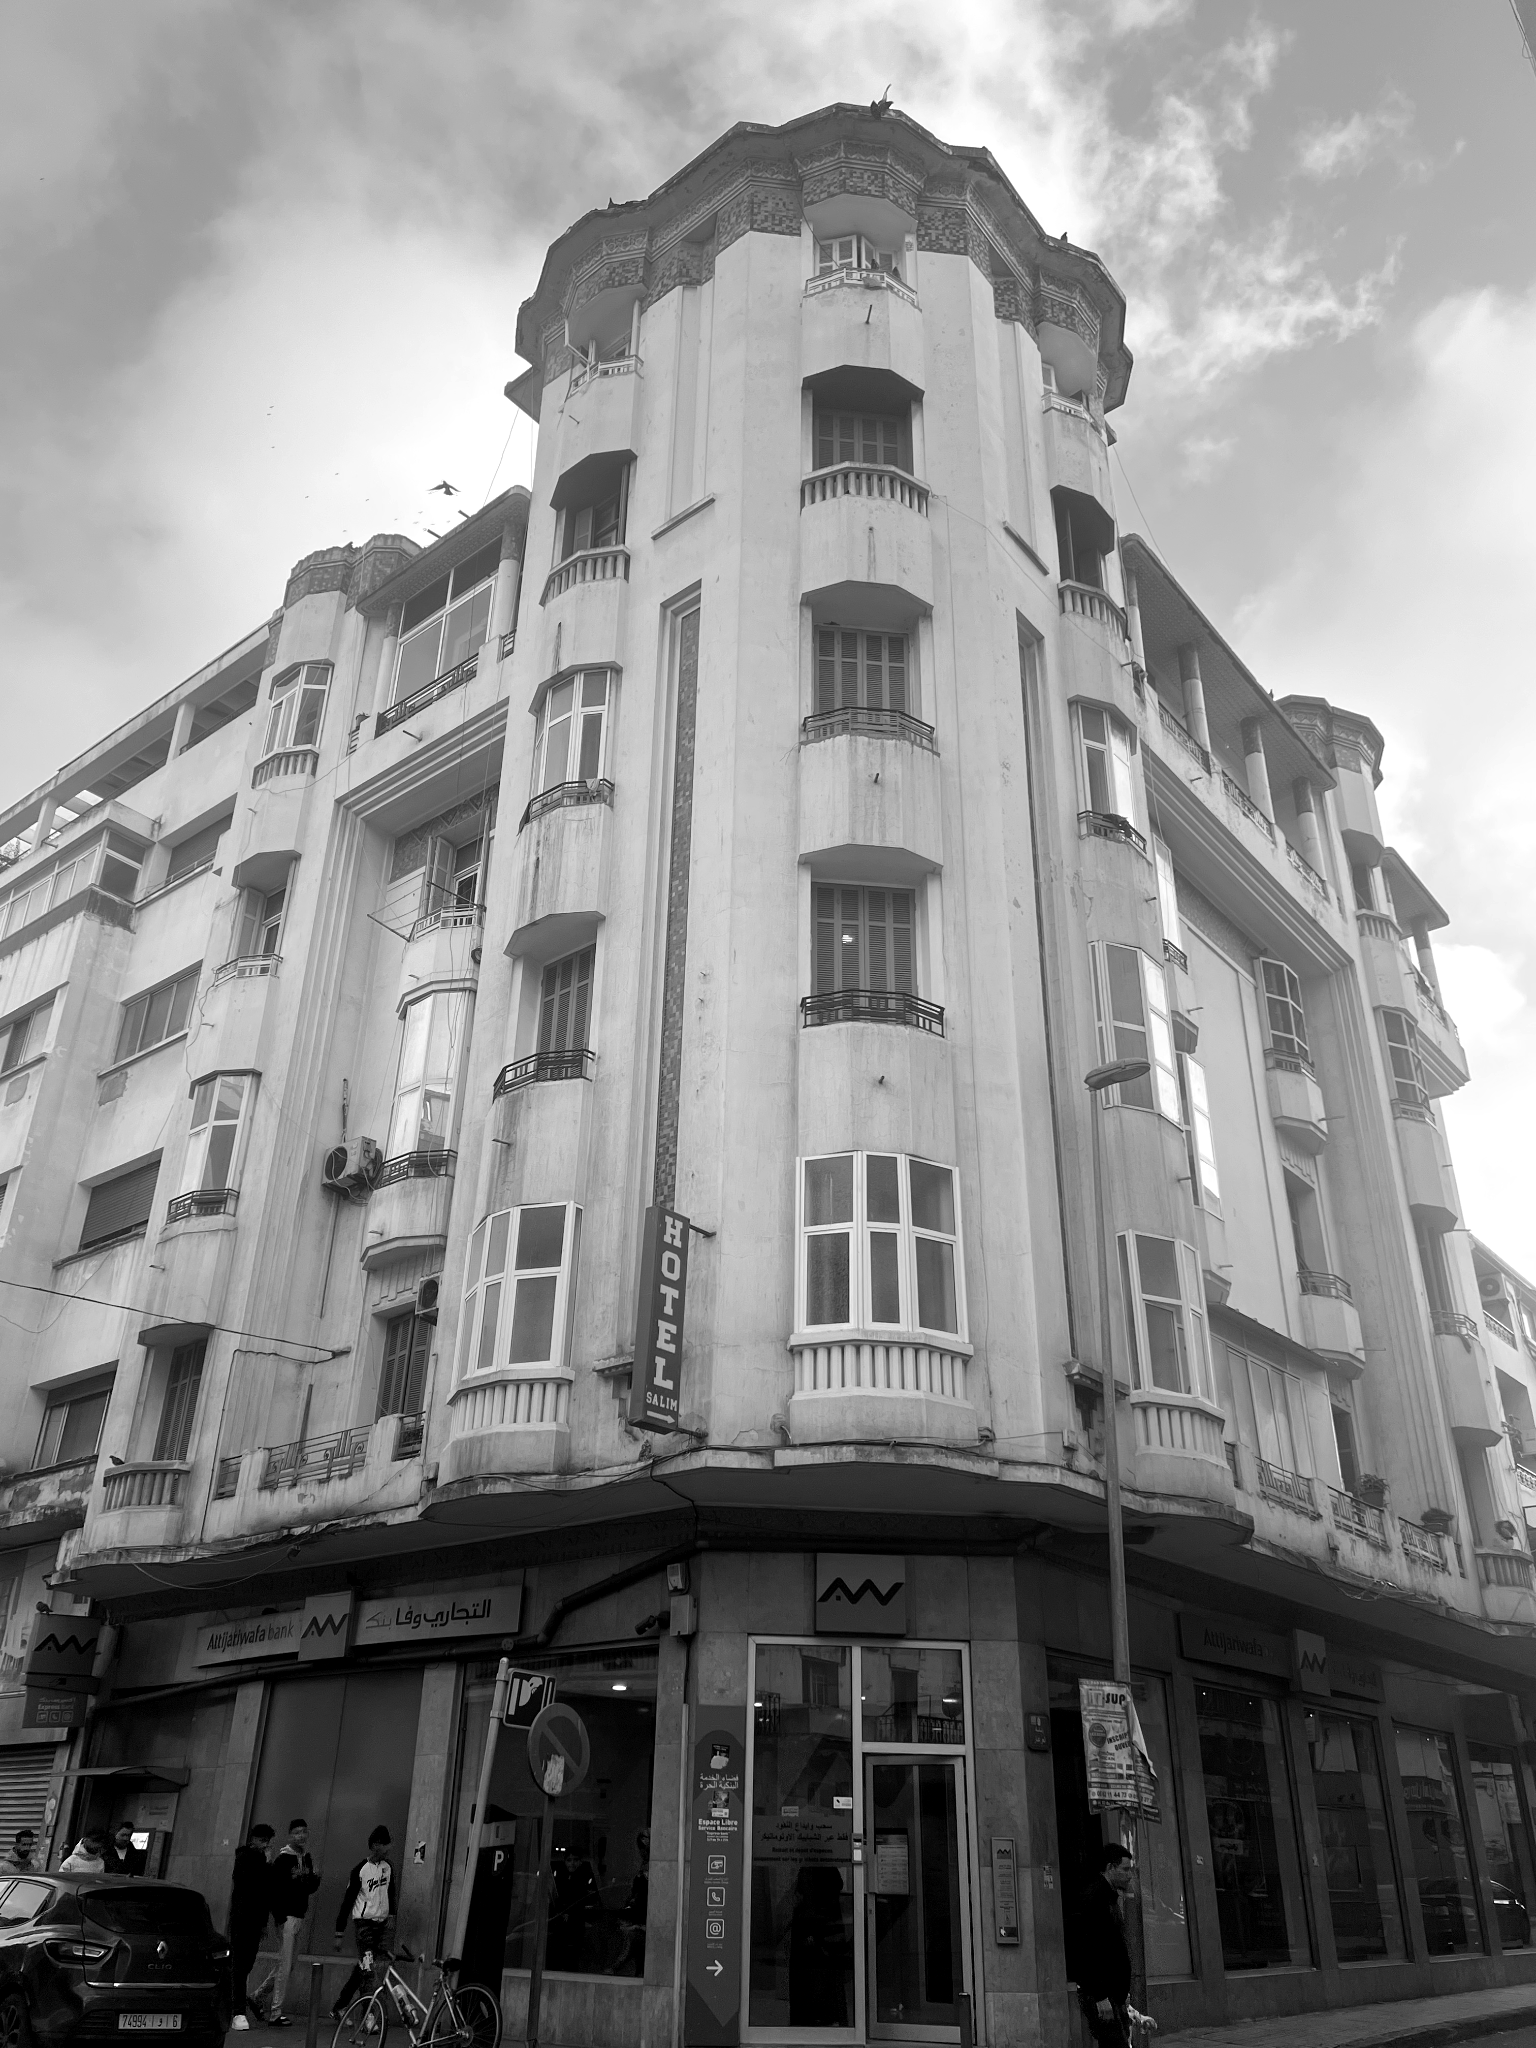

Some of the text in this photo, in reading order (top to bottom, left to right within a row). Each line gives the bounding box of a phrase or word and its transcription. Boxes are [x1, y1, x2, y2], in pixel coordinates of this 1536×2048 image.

[653, 1215, 683, 1390] HOTEL
[646, 1391, 678, 1412] SALIM
[423, 1599, 492, 1629] التجاري
[207, 1620, 293, 1653] Attijariwafa bank
[1203, 1628, 1263, 1658] Attijariwafa
[698, 1818, 738, 1827] Espace Libre
[122, 2014, 147, 2028] 74994
[172, 2014, 180, 2028] 6
